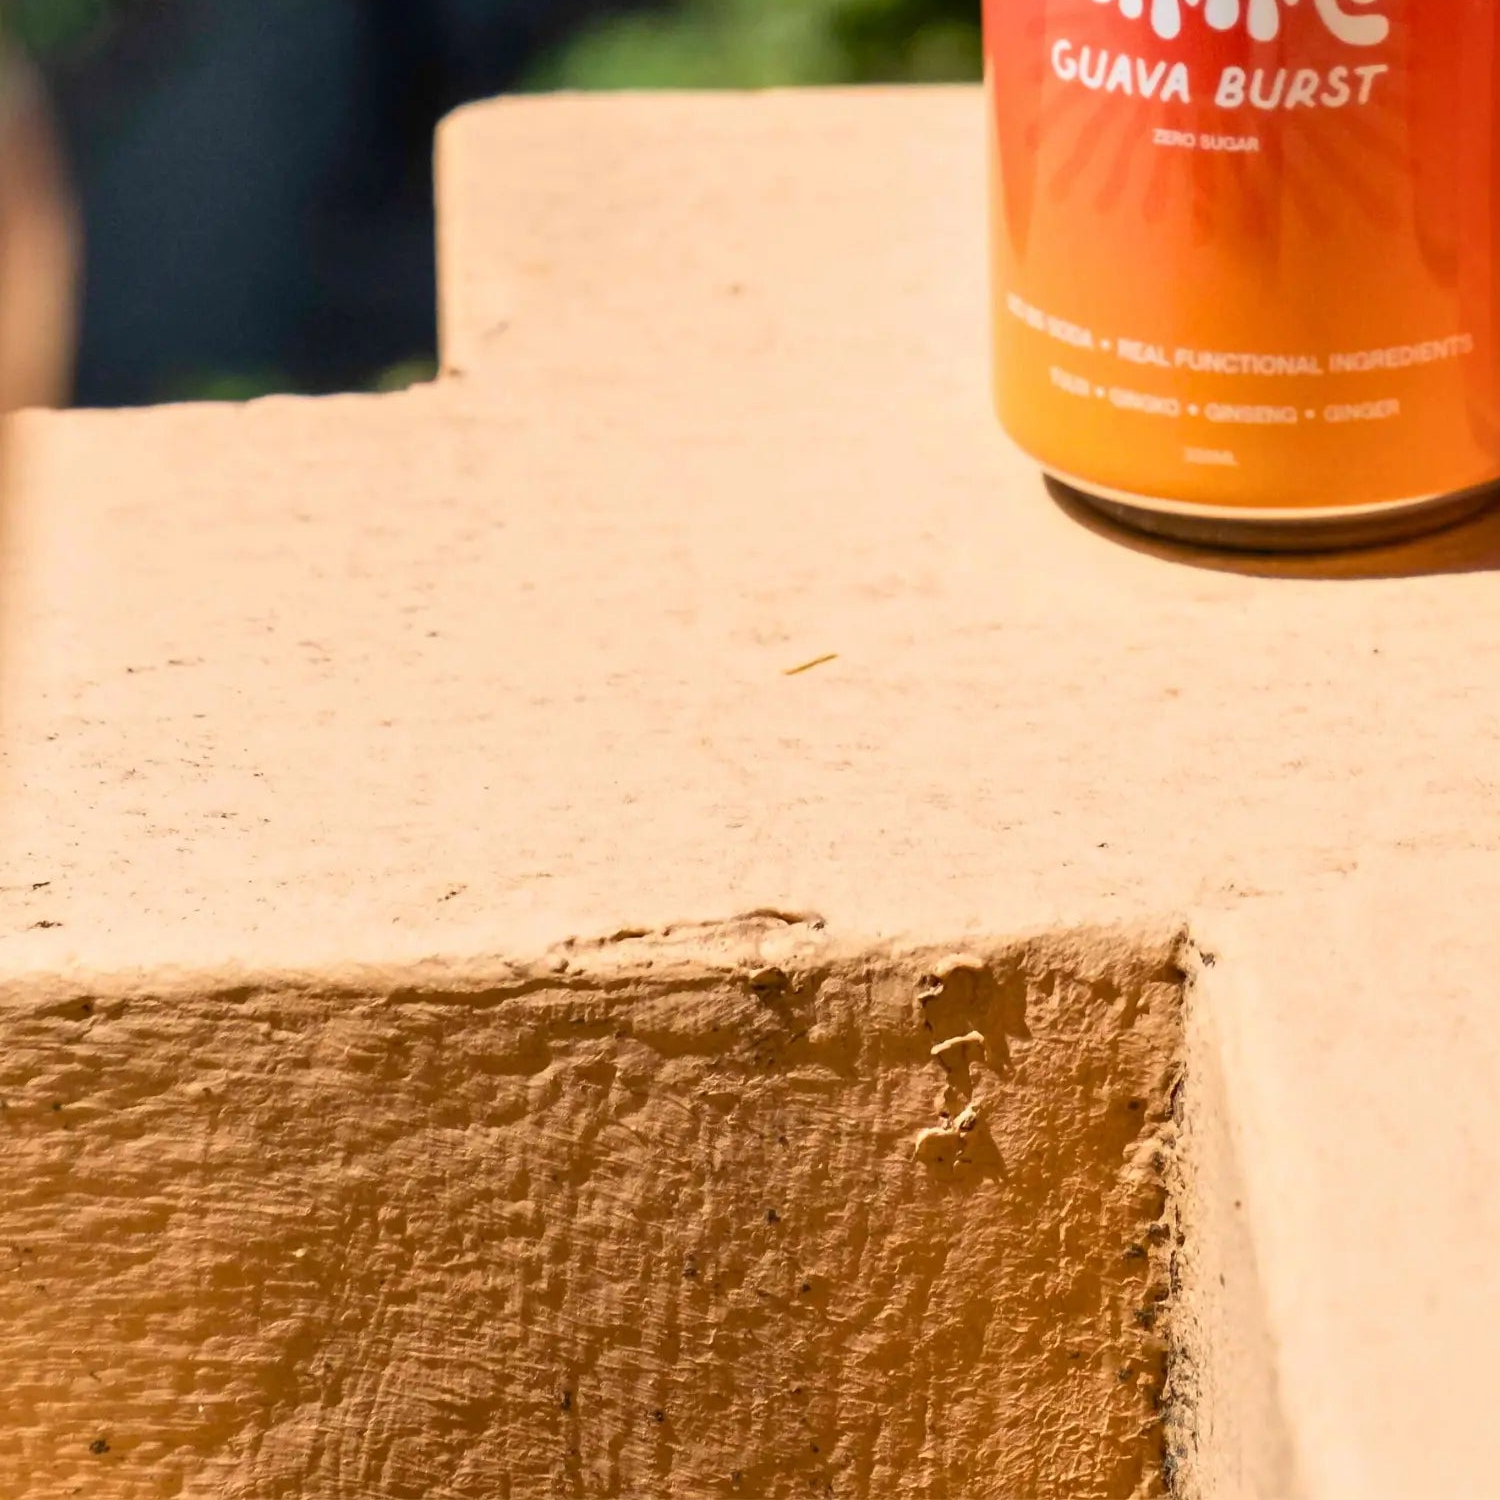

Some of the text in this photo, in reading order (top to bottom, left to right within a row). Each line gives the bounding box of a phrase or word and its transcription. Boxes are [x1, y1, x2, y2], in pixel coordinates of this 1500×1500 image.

[1051, 38, 1389, 111] GUAVA BURST
[1200, 132, 1260, 154] SUGAR
[1173, 347, 1323, 376] FUNCTIONAL
[1328, 332, 1474, 374] INGREDIENTS
